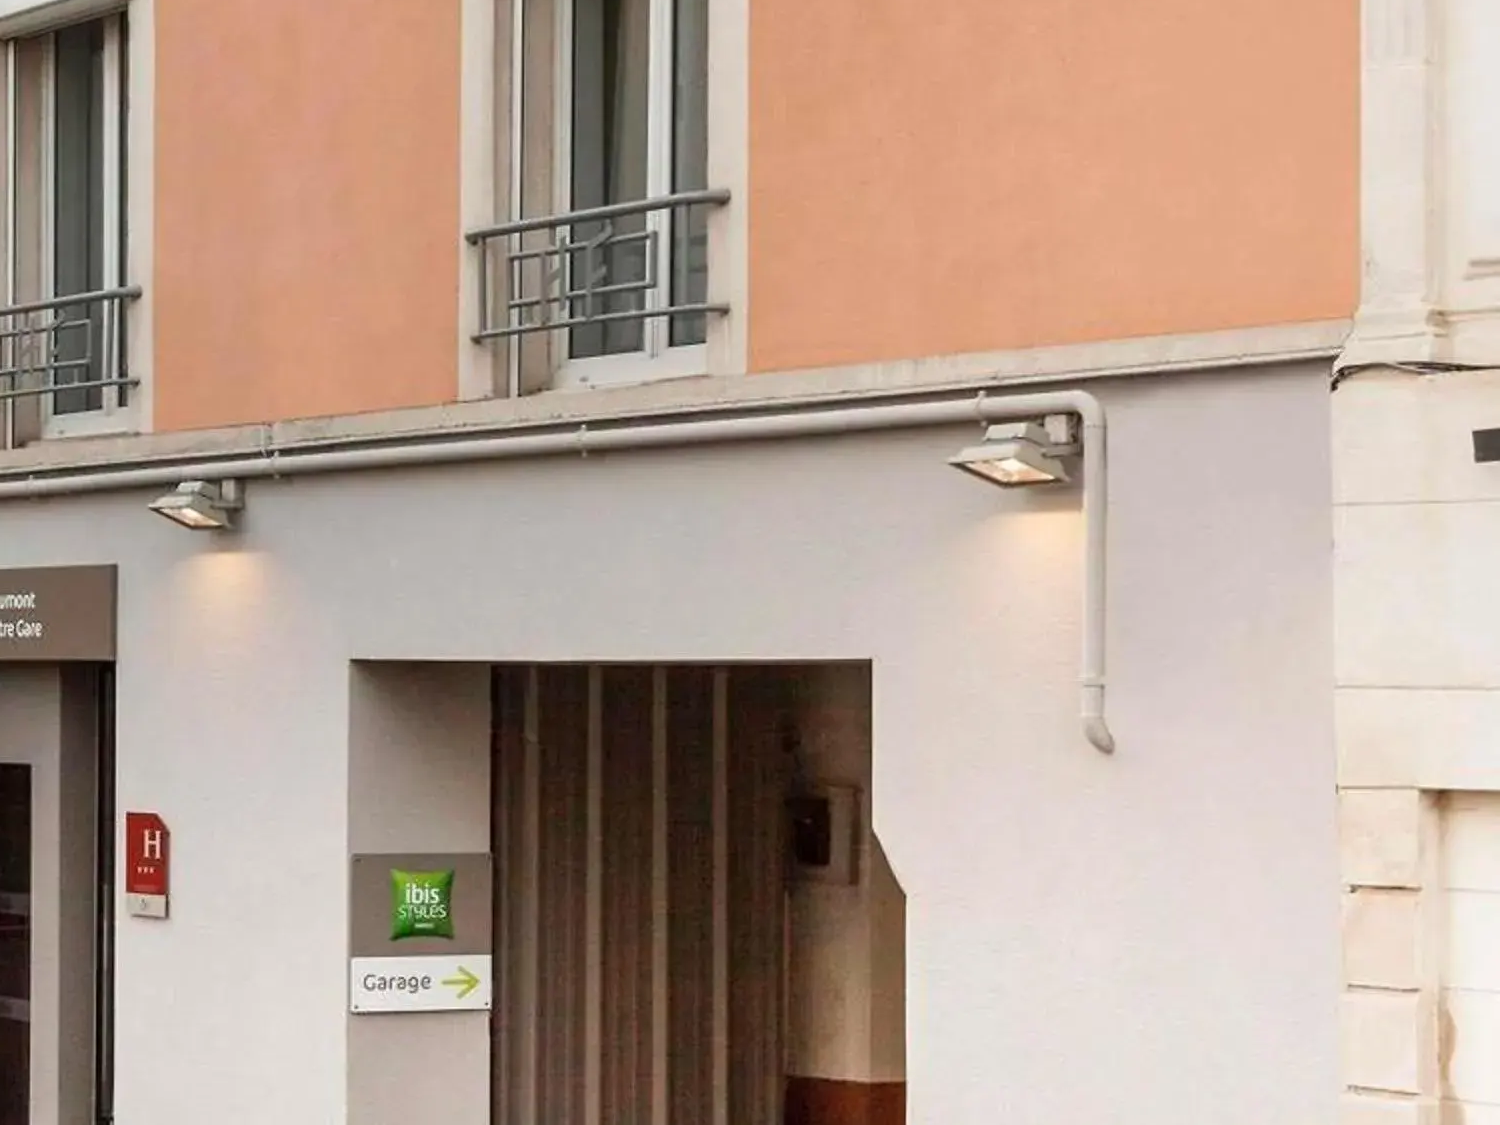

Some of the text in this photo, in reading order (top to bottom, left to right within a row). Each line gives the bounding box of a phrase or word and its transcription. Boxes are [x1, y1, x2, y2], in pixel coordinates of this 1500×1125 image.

[16, 619, 43, 638] Gare
[143, 829, 162, 860] H
[405, 882, 440, 905] ibis
[398, 904, 447, 919] STYLES
[363, 973, 432, 995] Garage
